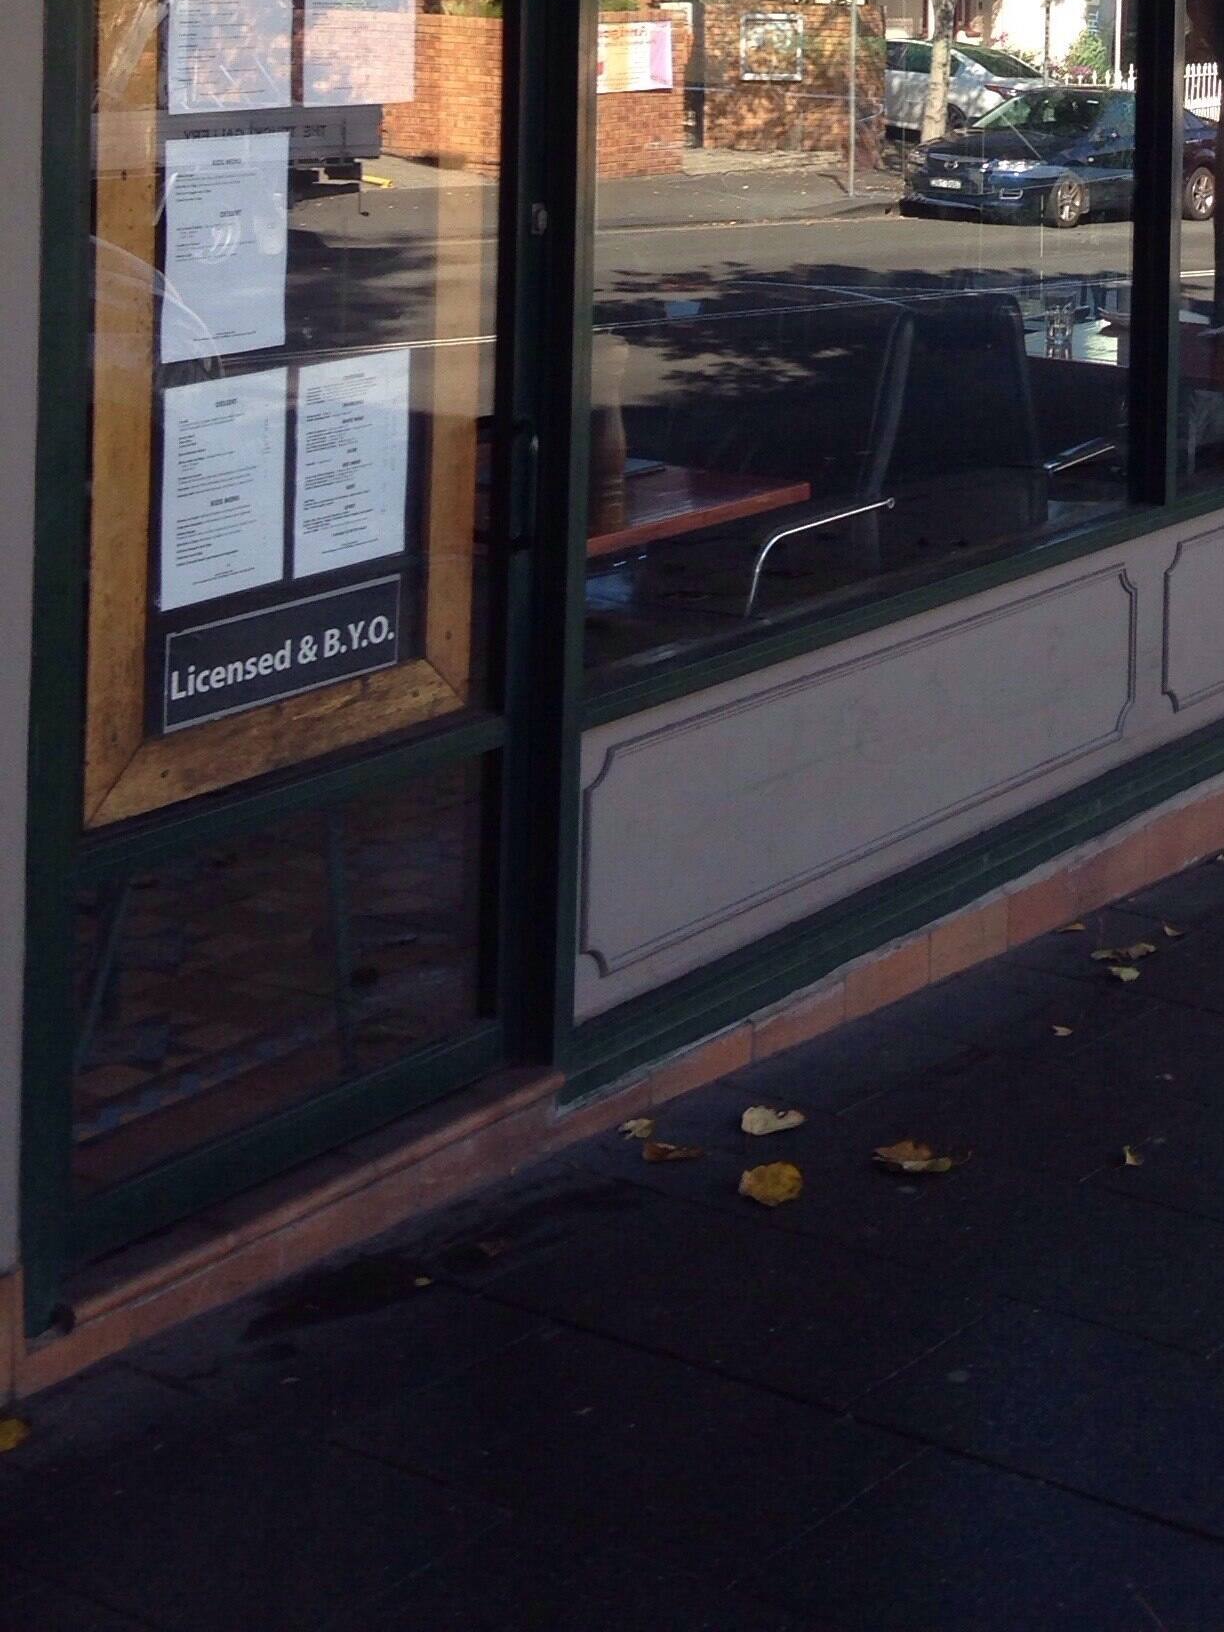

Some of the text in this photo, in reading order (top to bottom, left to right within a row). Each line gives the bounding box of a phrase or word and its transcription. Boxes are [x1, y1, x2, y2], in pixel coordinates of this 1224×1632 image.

[171, 615, 396, 700] Licensed & B.Y.O.
